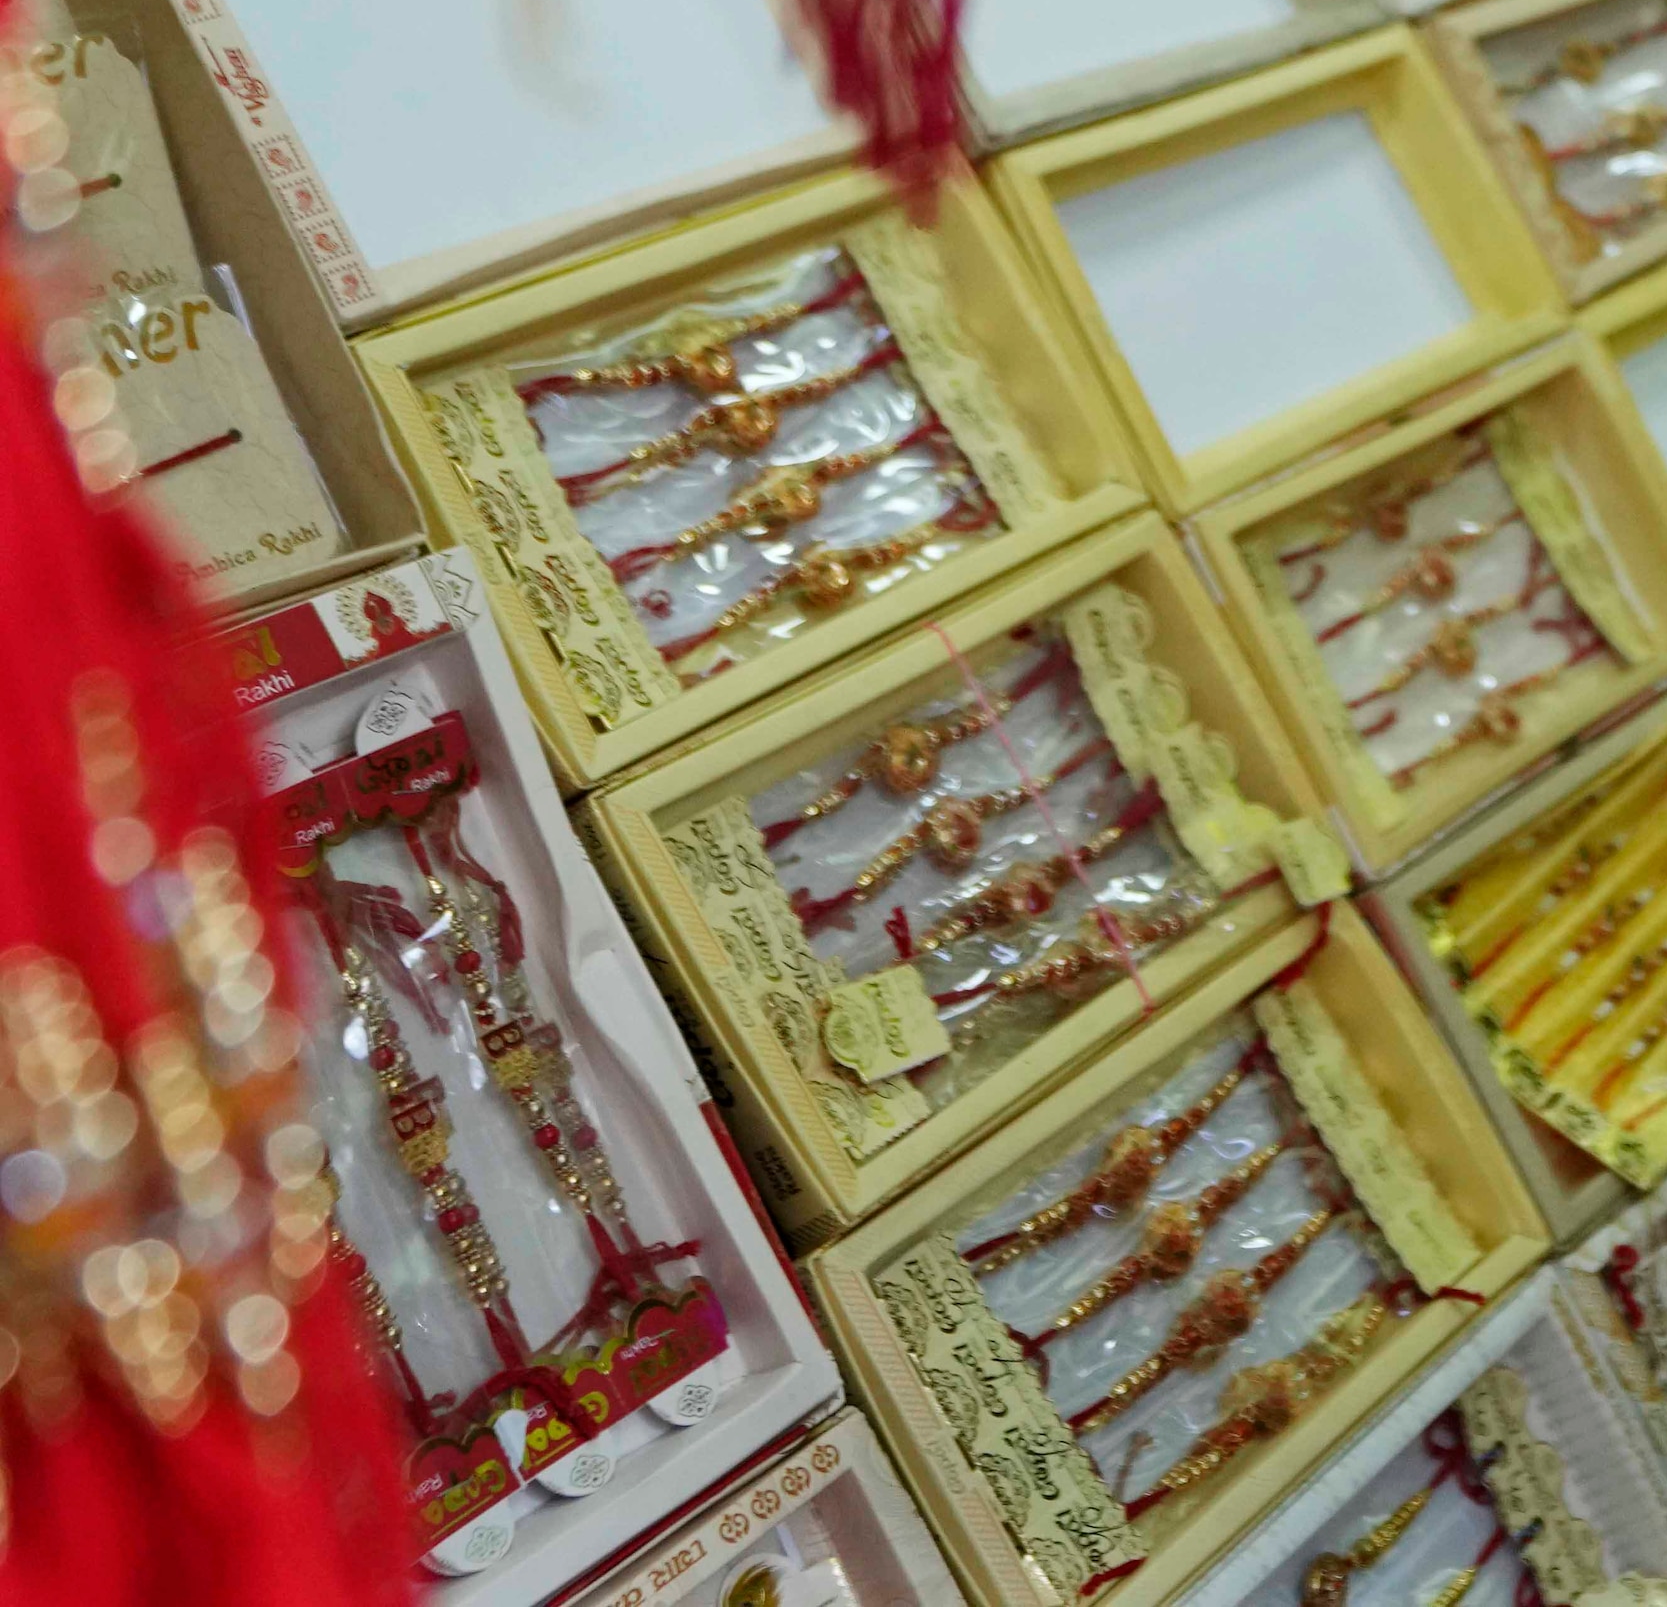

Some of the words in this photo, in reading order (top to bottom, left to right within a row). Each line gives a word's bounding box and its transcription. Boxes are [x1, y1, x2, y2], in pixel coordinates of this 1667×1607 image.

[235, 670, 295, 707] Rakhi
[411, 769, 449, 793] Rakhi
[295, 820, 336, 844] Rakhi
